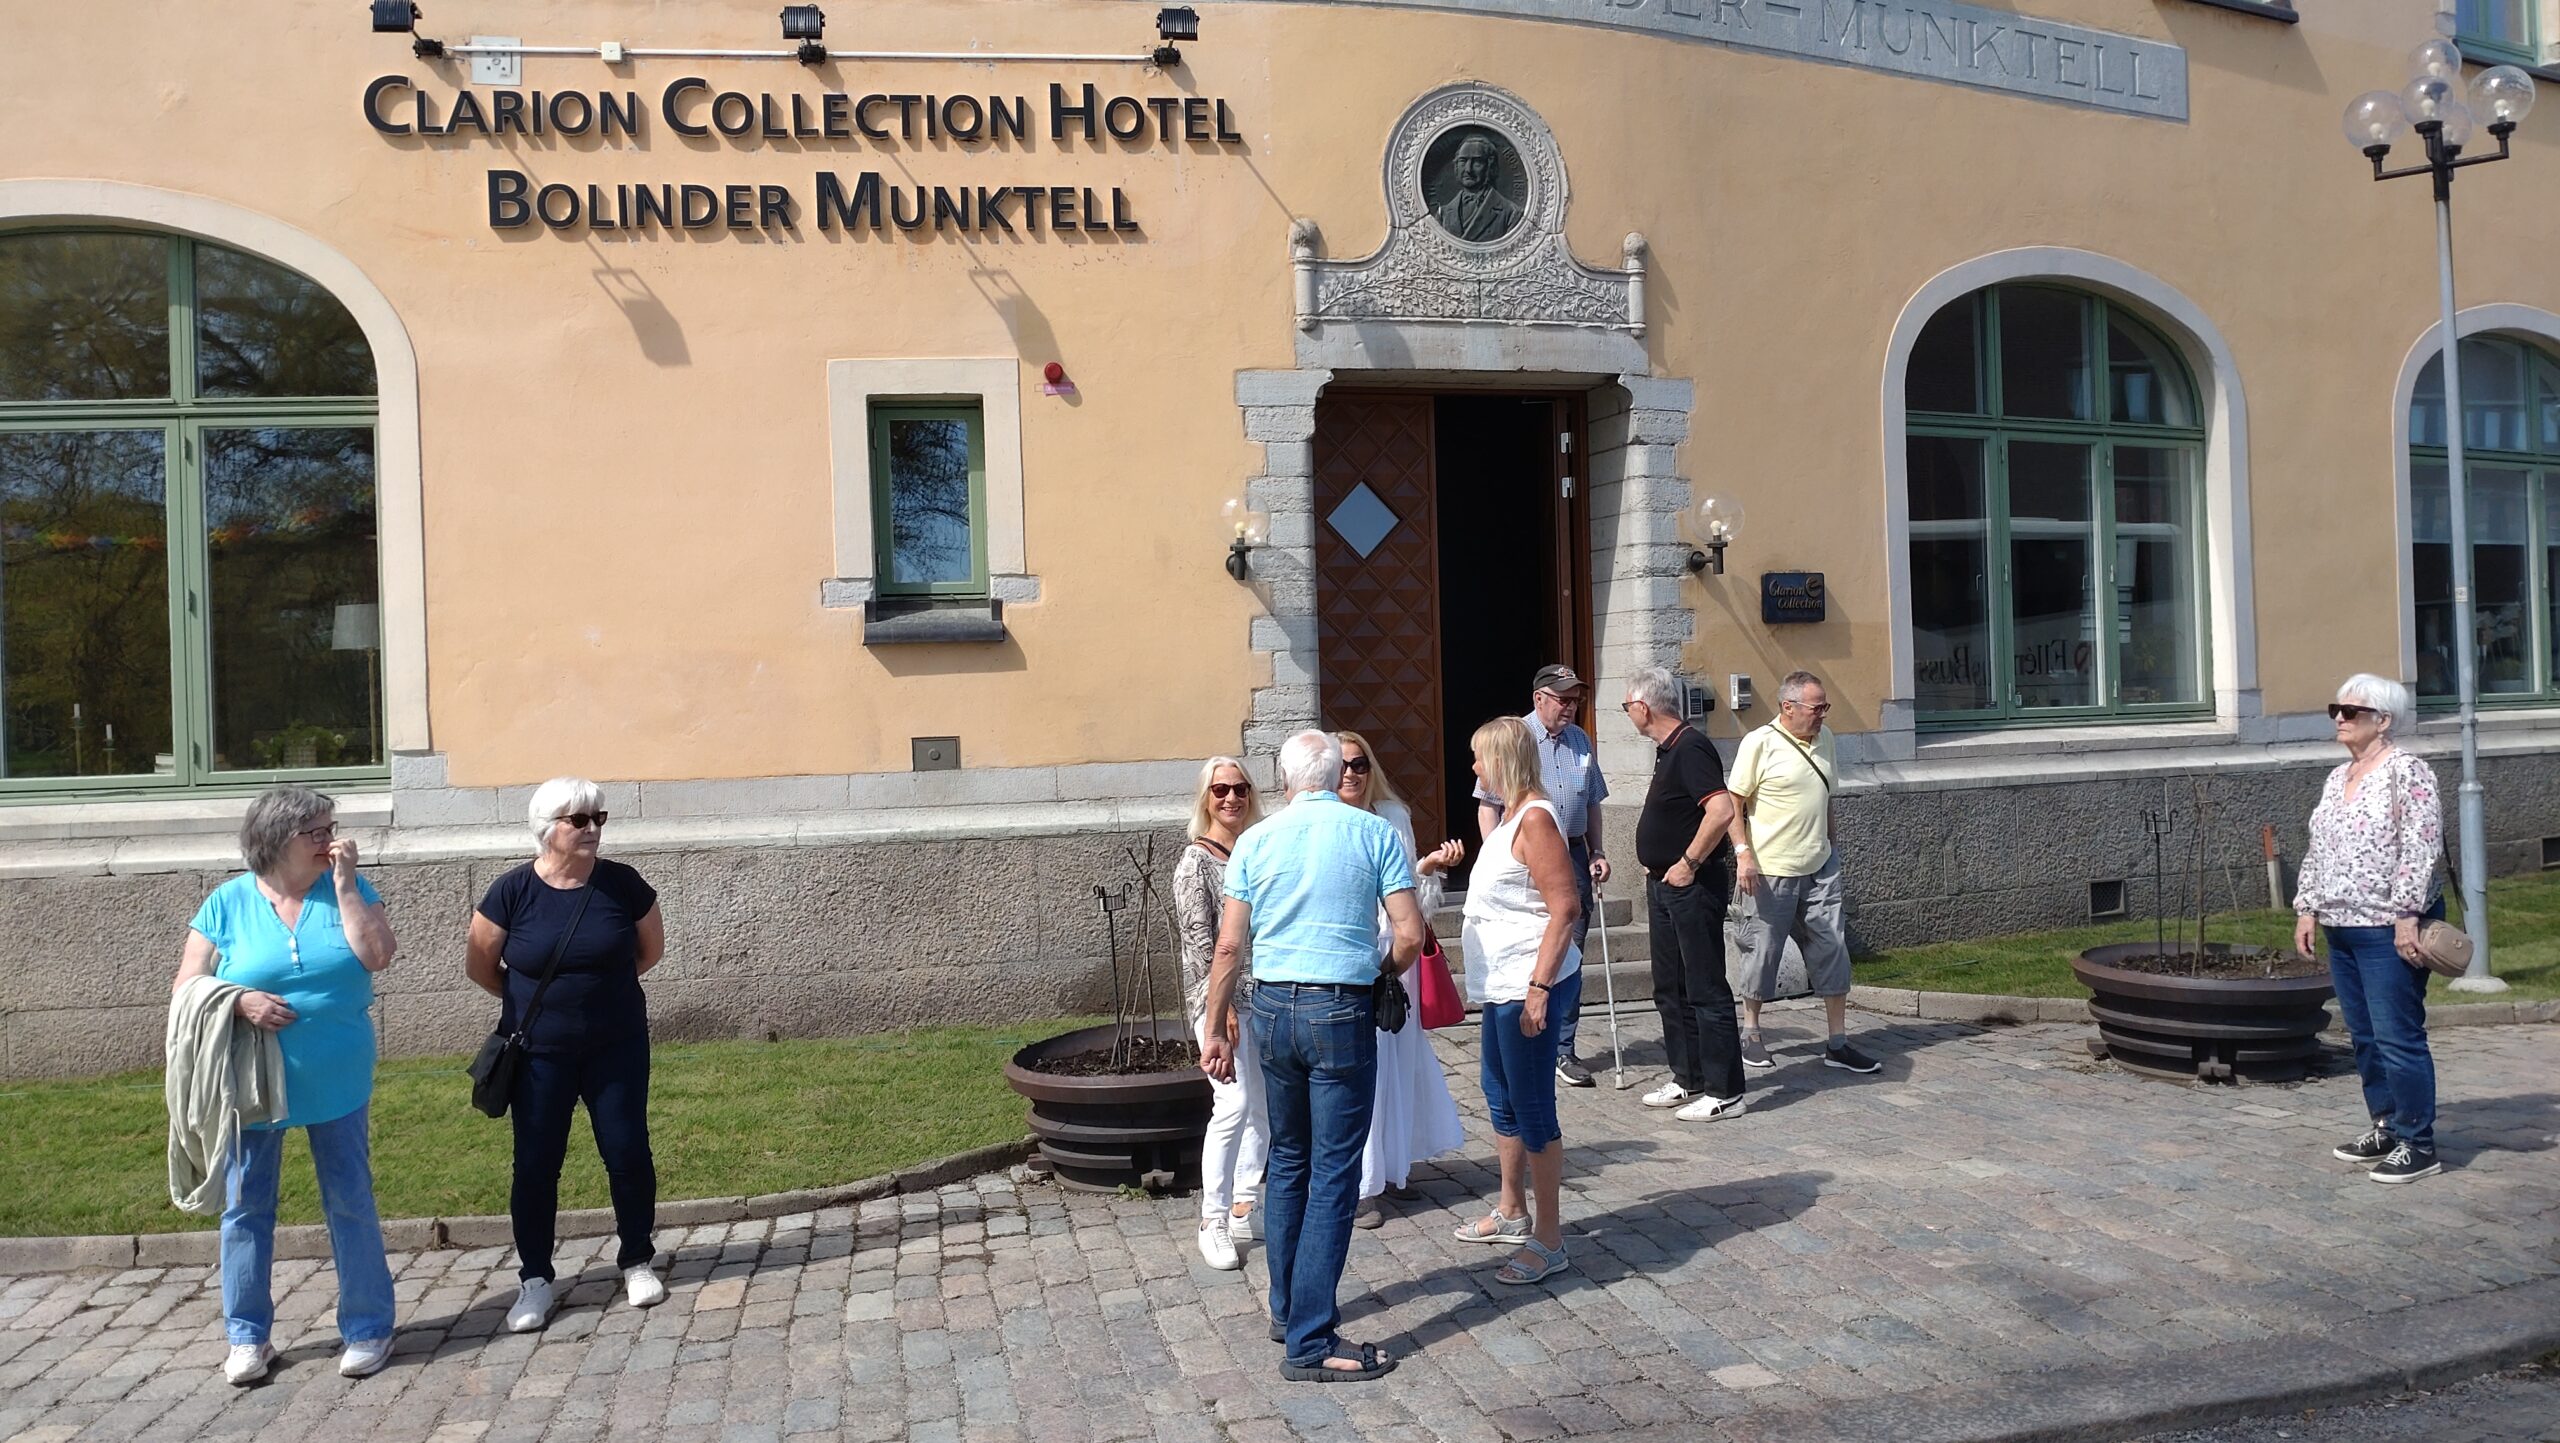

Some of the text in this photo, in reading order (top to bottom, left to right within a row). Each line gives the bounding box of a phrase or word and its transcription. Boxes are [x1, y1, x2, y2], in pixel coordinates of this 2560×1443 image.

[362, 74, 1242, 143] CLARION COLLECTION HOTEL
[487, 169, 1138, 233] BOLINDER MUNKTELL
[1768, 579, 1805, 597] Clarion
